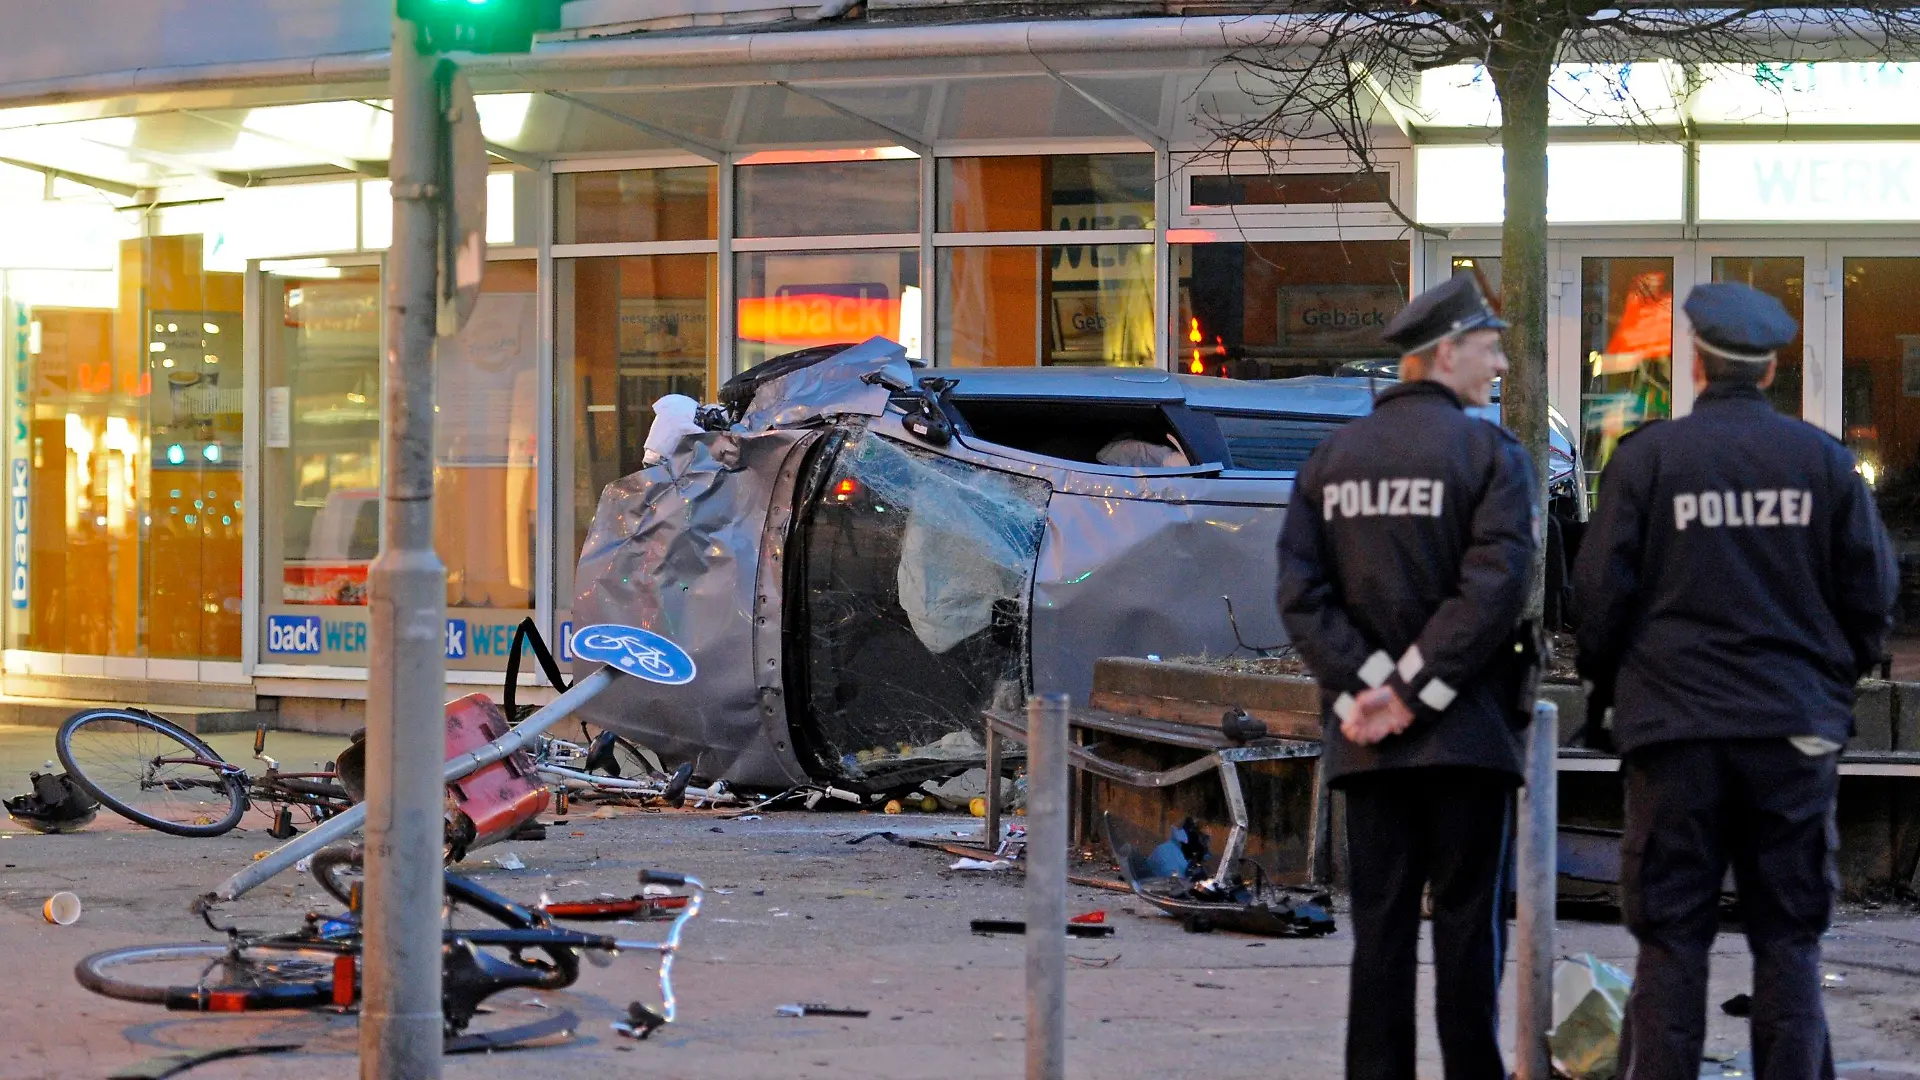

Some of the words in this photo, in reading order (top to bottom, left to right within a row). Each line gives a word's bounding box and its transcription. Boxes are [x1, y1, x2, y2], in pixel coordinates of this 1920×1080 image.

[1752, 158, 1912, 205] WERK
[781, 286, 884, 335] back
[1302, 307, 1385, 326] Gebäck
[1323, 478, 1444, 521] POLIZEI
[1673, 488, 1813, 531] POLIZEI
[12, 459, 28, 601] back
[269, 617, 319, 651] back
[324, 621, 367, 652] WER
